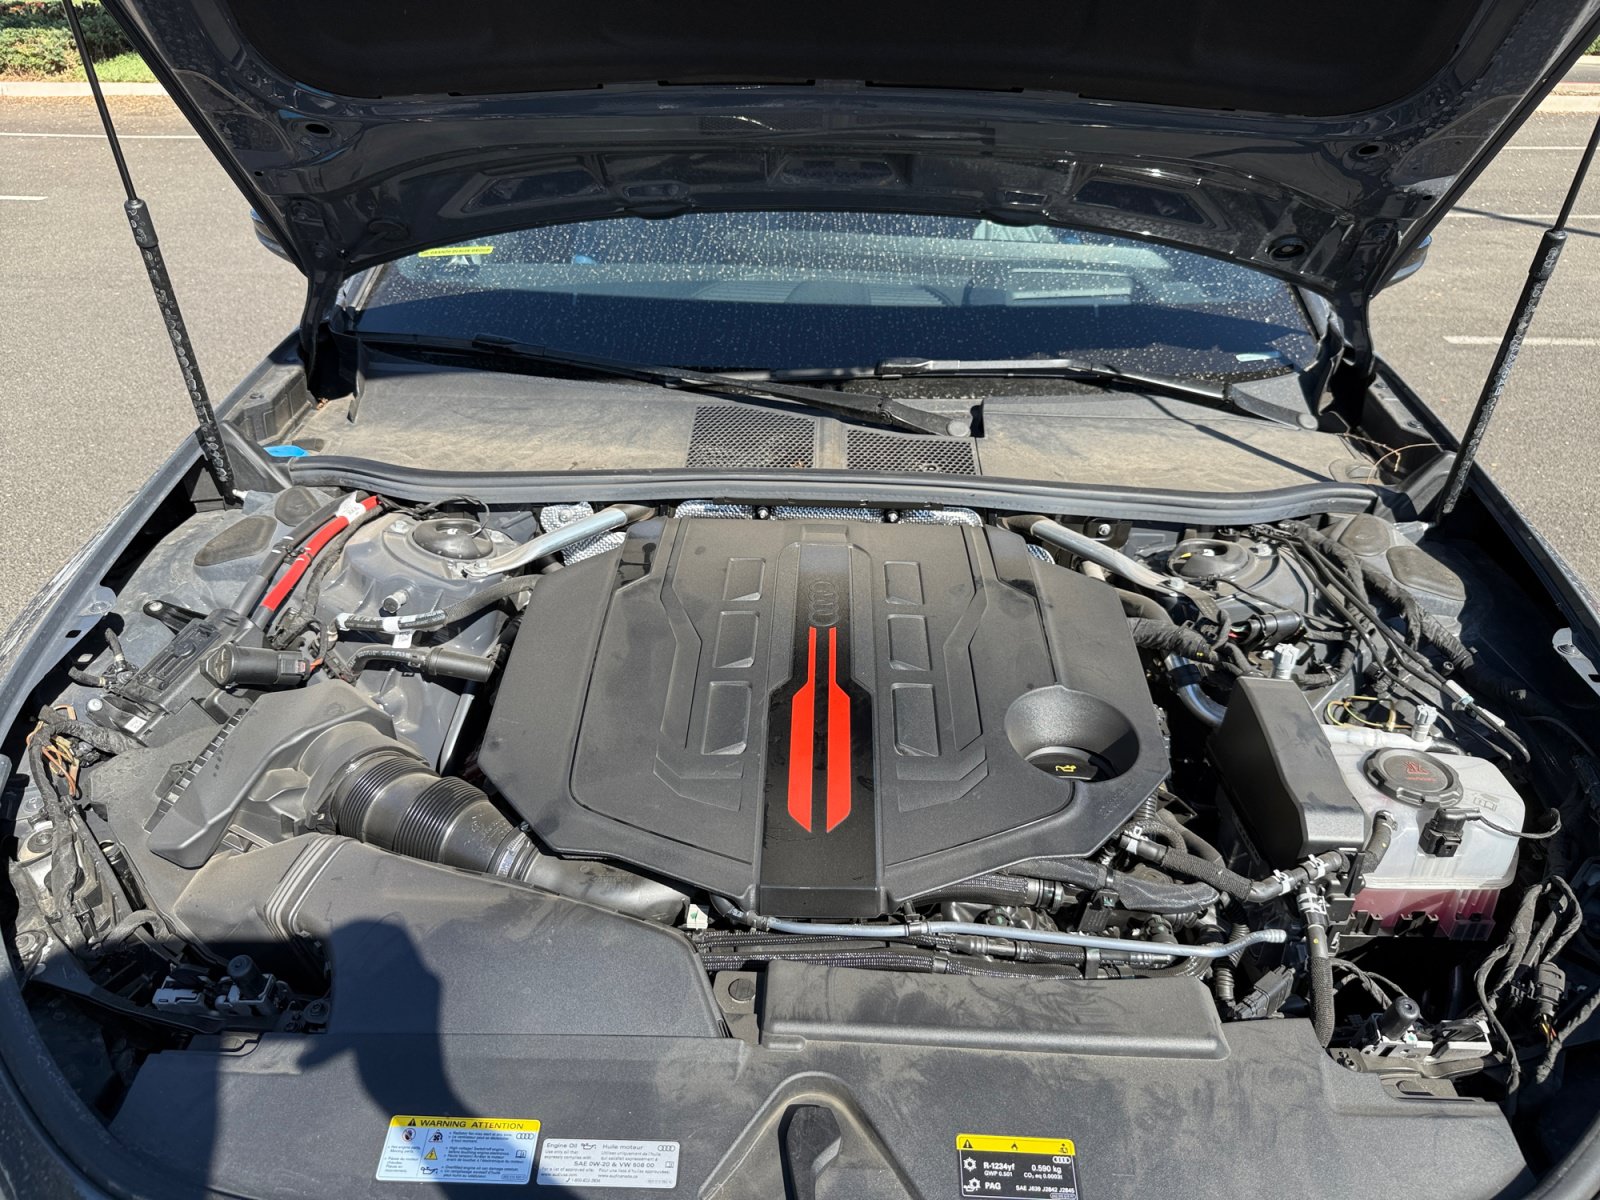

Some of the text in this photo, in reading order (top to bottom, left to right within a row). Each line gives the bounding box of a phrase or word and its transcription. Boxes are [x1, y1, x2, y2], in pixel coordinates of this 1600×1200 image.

[420, 1119, 524, 1130] WARNING ATTENTION
[983, 1162, 1015, 1171] R-1234yf
[1031, 1164, 1062, 1174] 0.590 kg
[984, 1181, 1002, 1190] PAG
